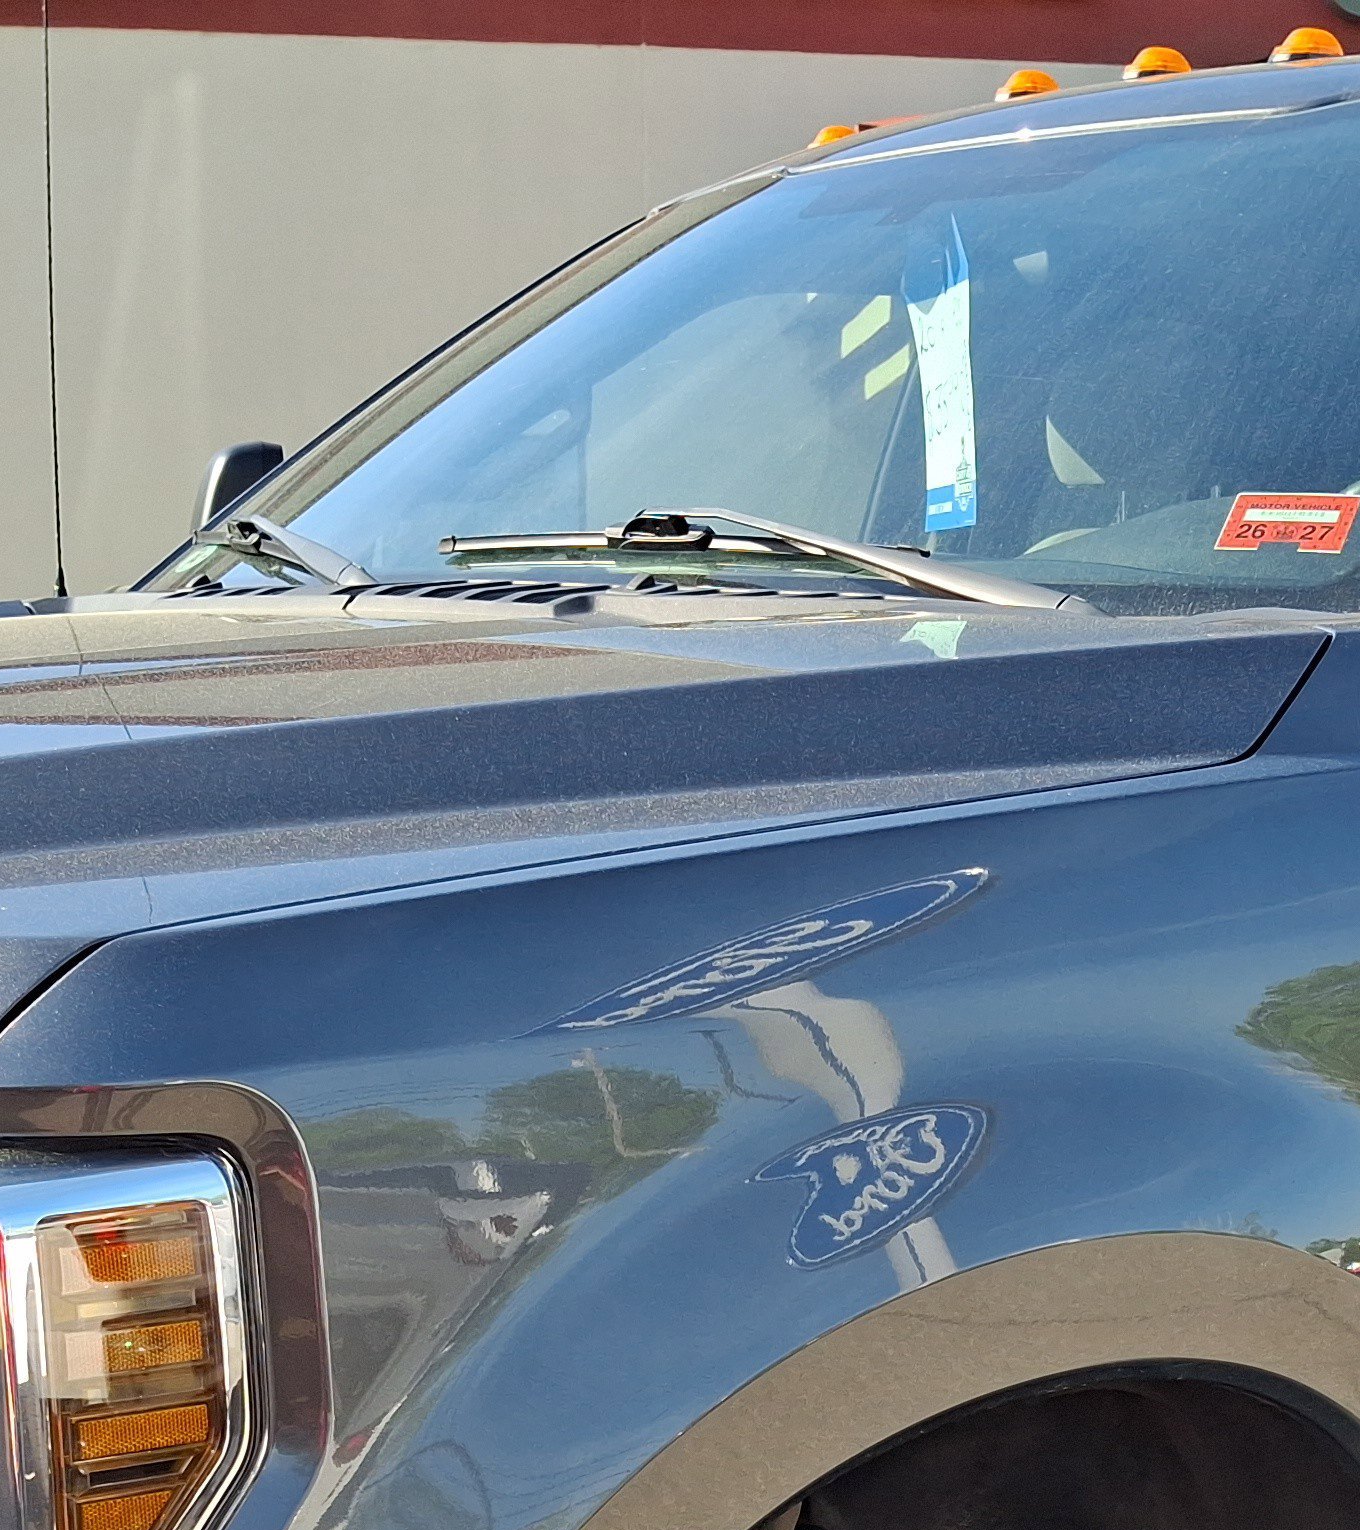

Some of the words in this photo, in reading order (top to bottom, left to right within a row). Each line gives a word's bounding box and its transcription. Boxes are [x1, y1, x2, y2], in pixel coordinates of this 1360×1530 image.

[1294, 503, 1343, 511] VEHICLE
[1234, 523, 1268, 539] 26
[1298, 524, 1335, 541] 27
